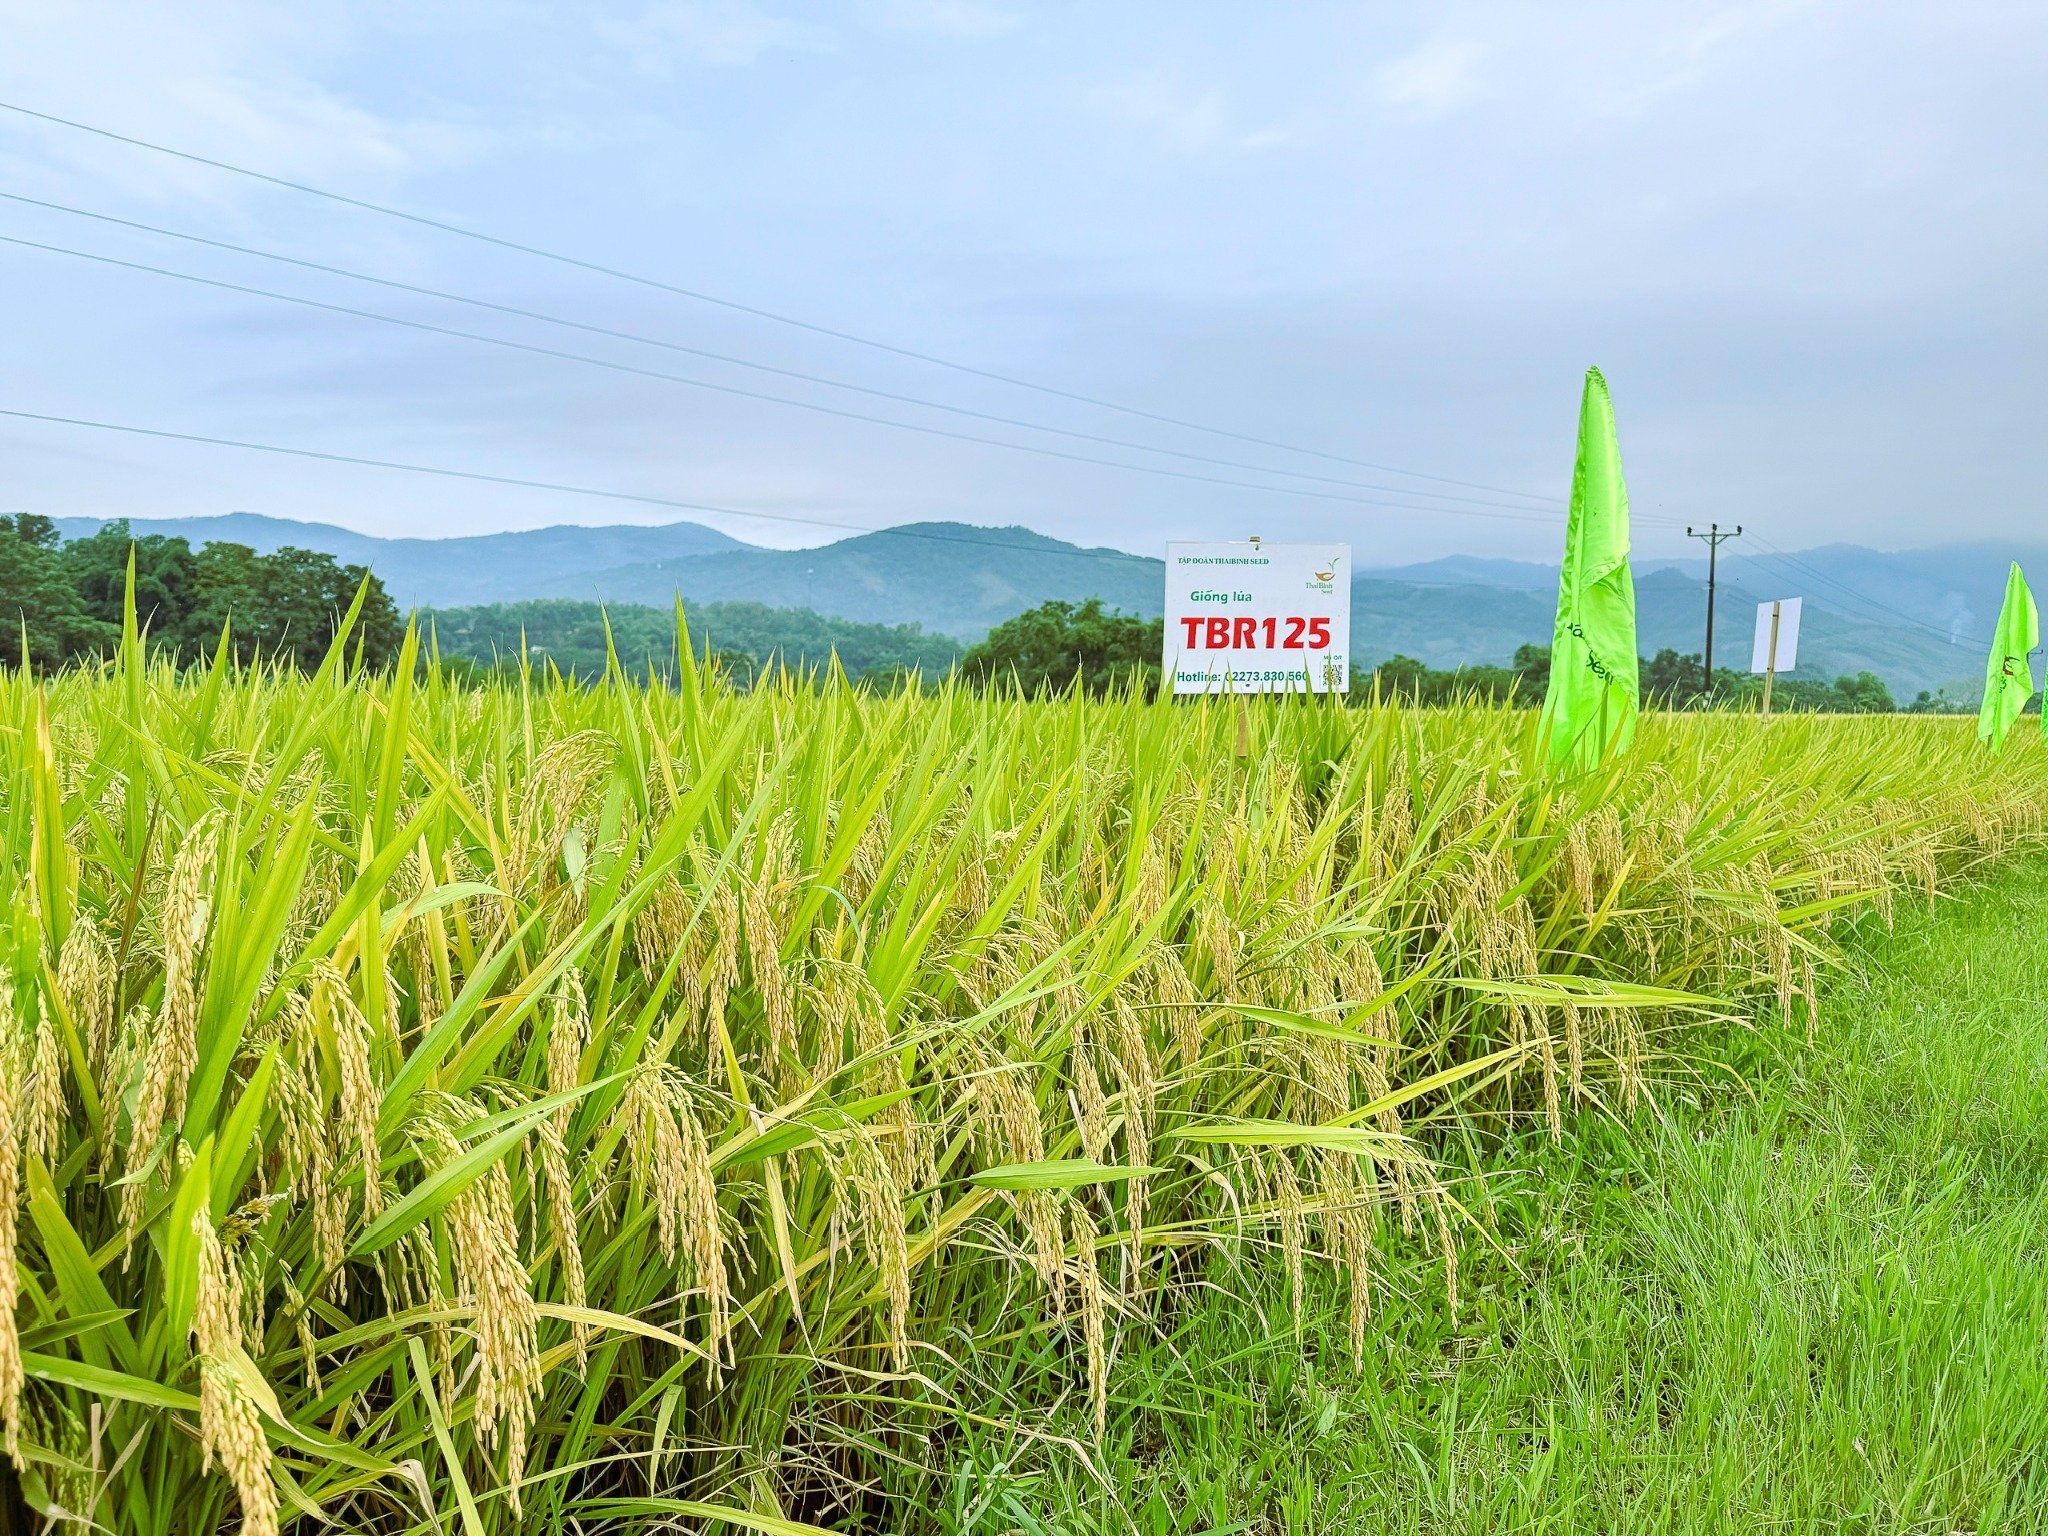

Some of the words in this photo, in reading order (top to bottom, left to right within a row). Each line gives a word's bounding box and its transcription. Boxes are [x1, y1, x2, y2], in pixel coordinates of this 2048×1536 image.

[1190, 589, 1228, 604] Giống
[1233, 590, 1252, 602] lúa
[1180, 617, 1331, 650] TBR125
[1177, 671, 1221, 682] Hotline:
